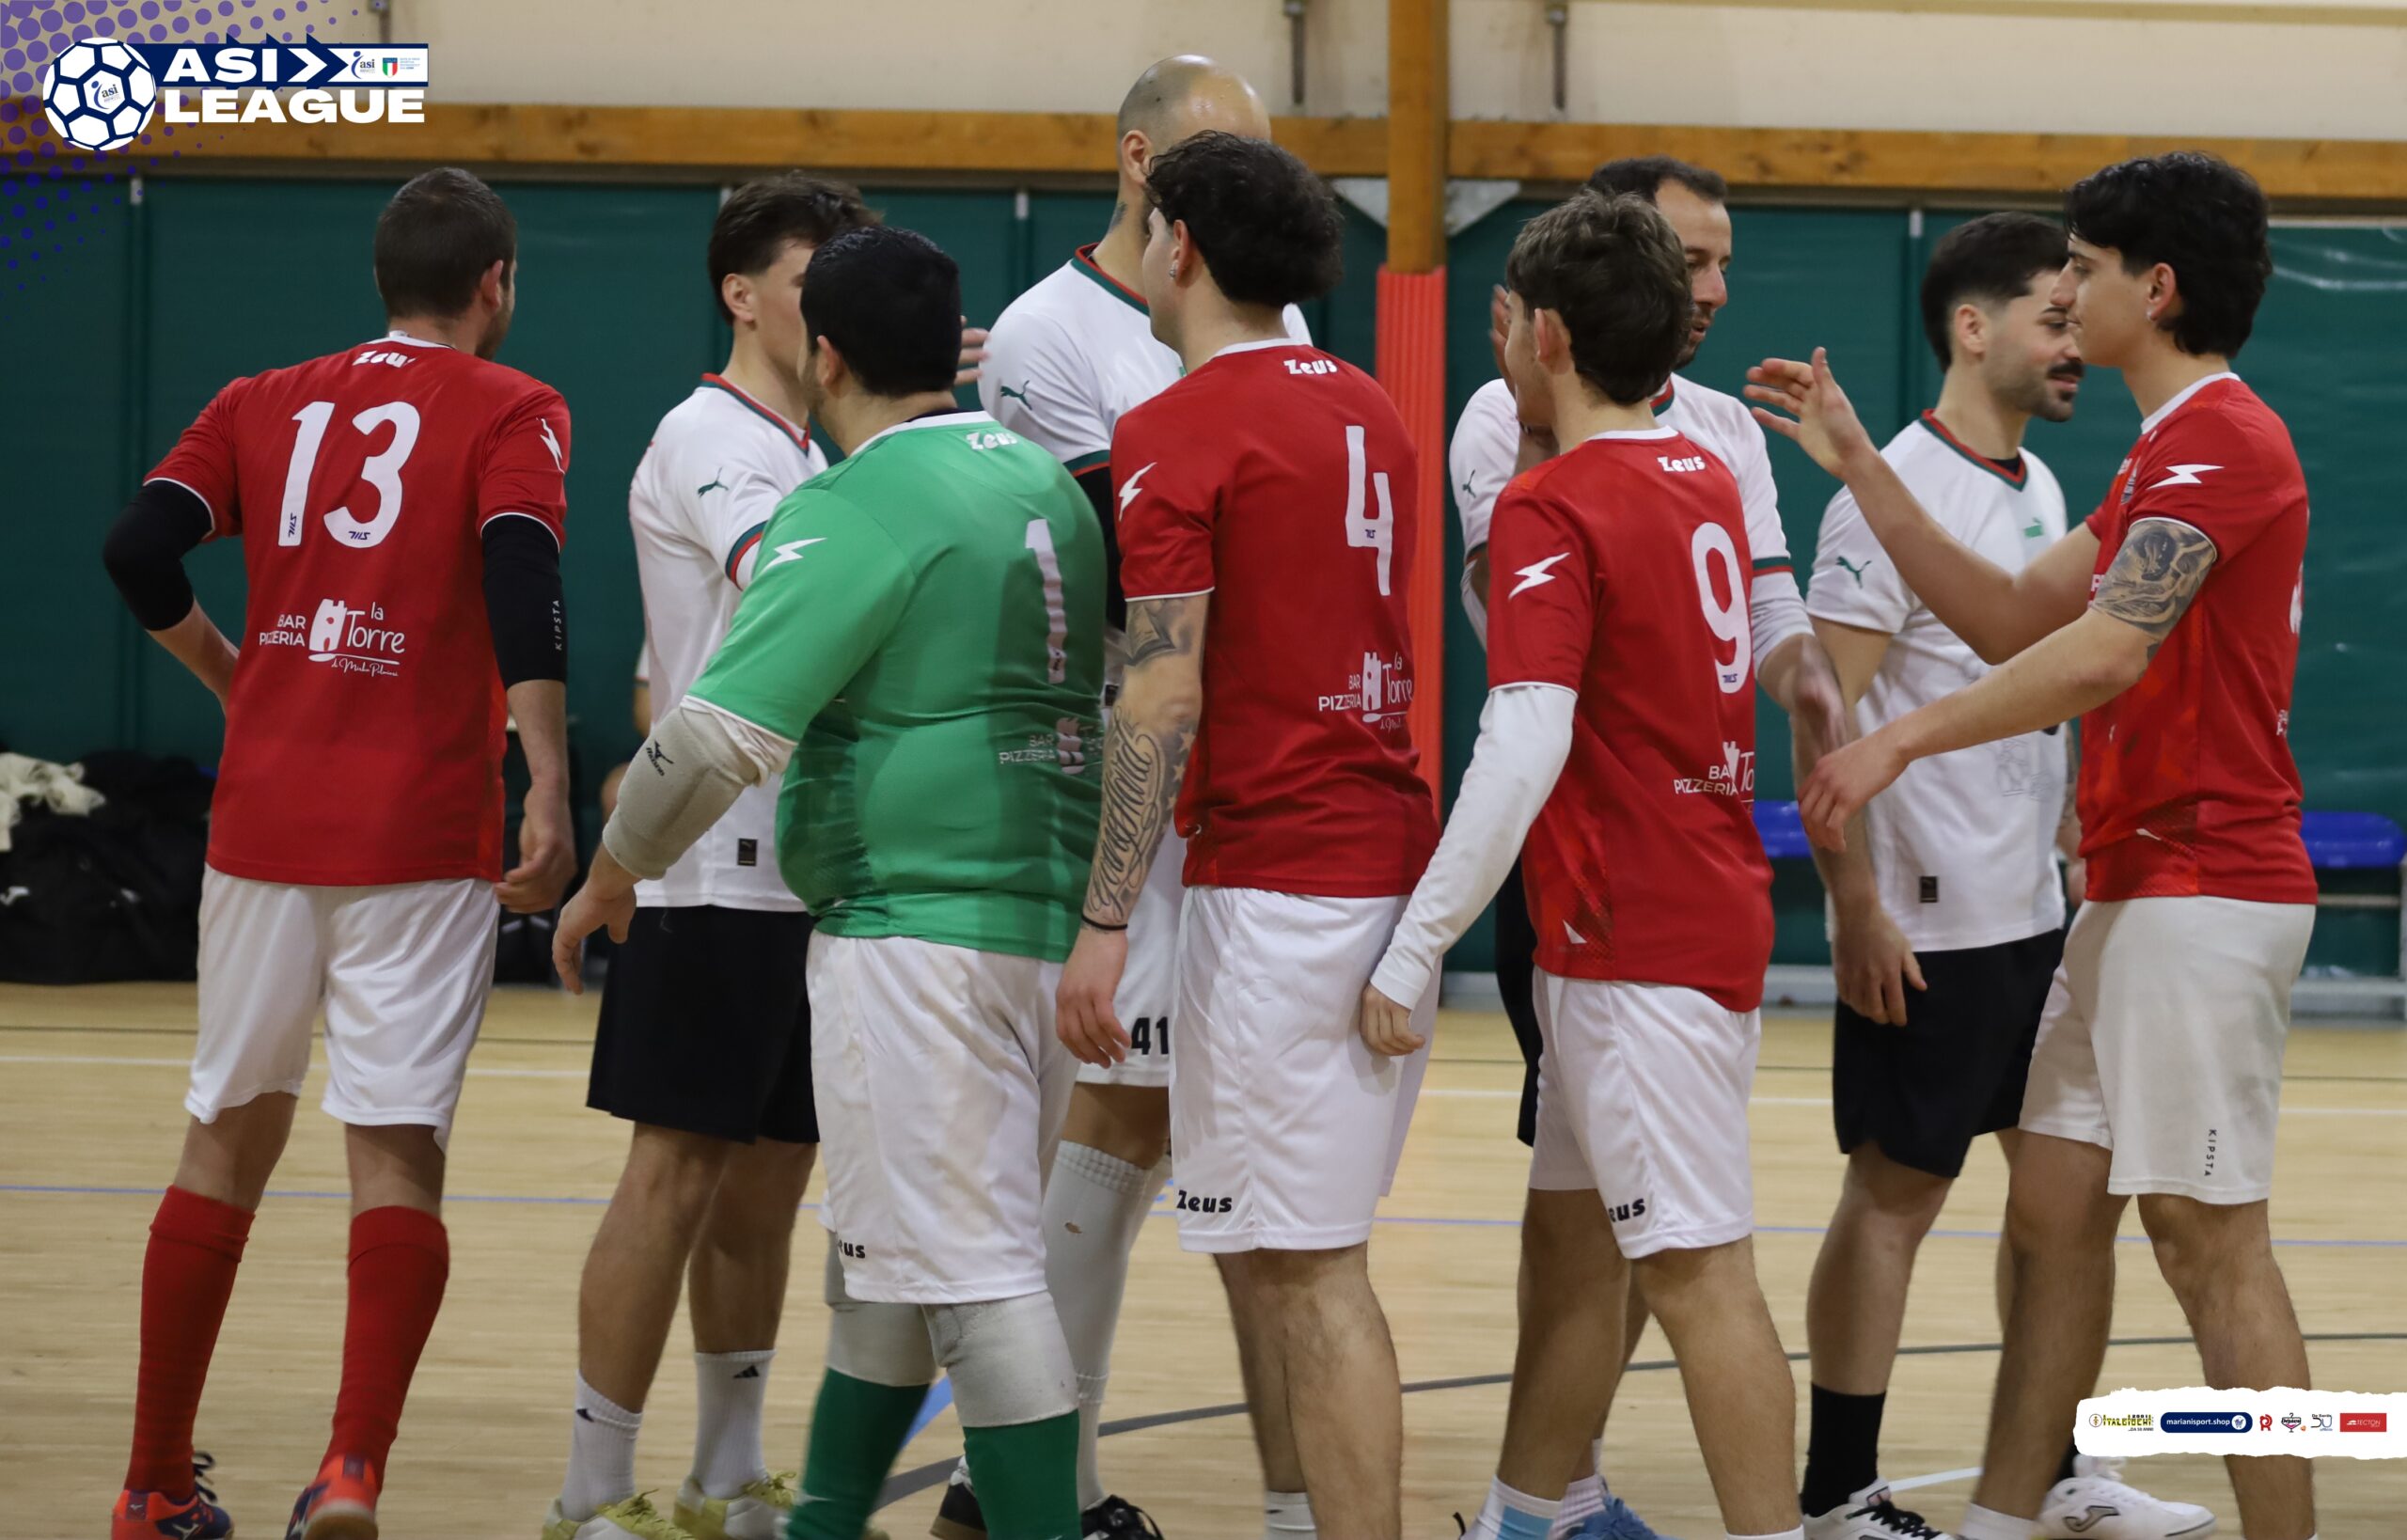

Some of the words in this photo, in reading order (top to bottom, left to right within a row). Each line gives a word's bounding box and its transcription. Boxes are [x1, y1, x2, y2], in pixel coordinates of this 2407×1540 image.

[1282, 358, 1338, 375] Zeus
[966, 432, 1017, 449] Zeus
[278, 401, 420, 548] 13
[1657, 455, 1706, 472] Zeus
[1345, 425, 1393, 596] 4
[370, 602, 385, 621] la
[1025, 518, 1067, 684] 1
[1691, 522, 1753, 694] 9
[277, 614, 307, 630] BAR
[346, 611, 405, 653] Torre
[552, 600, 562, 651] KIPSTA
[1382, 663, 1414, 705] Torre
[1673, 778, 1738, 796] PIZZERIA
[1708, 764, 1733, 780] BA
[1131, 1016, 1169, 1055] 41
[2204, 1128, 2217, 1176] KIPSTA
[1176, 1190, 1233, 1213] Zeus
[1609, 1198, 1645, 1223] eus
